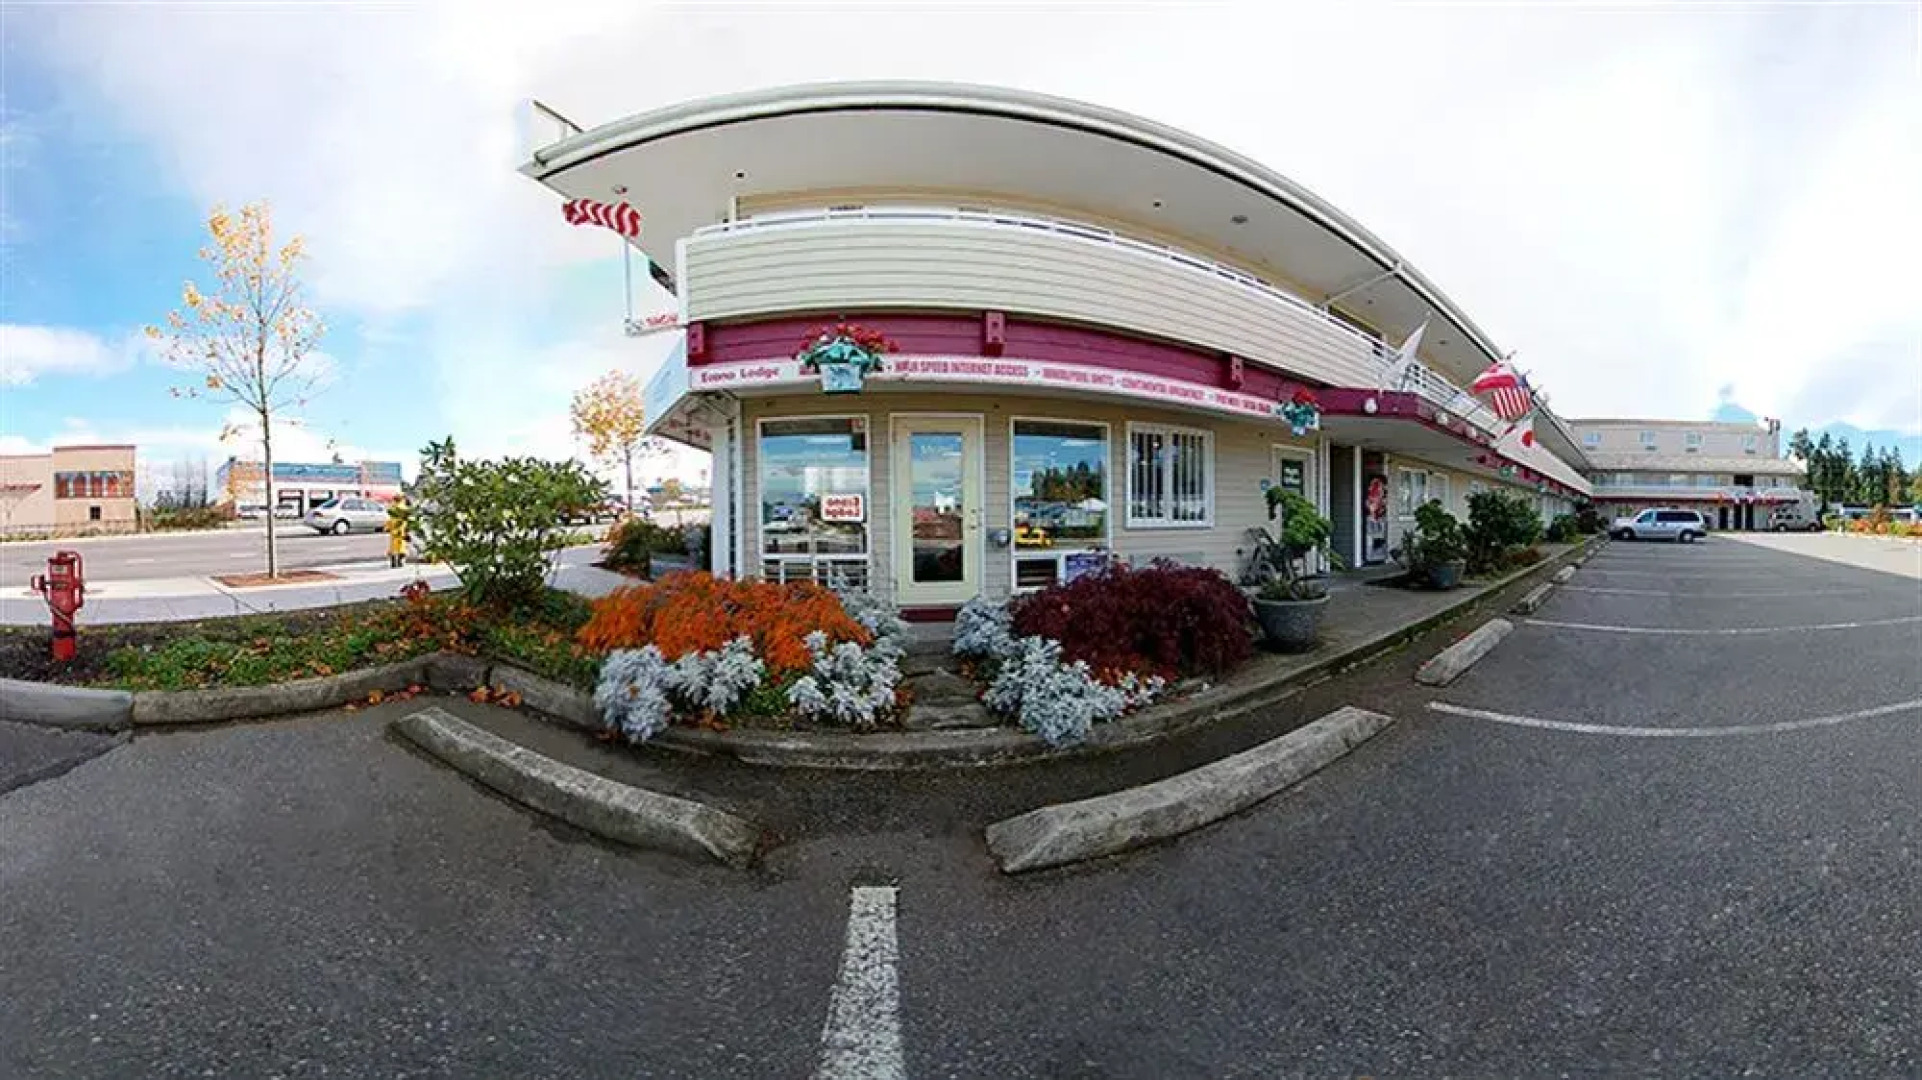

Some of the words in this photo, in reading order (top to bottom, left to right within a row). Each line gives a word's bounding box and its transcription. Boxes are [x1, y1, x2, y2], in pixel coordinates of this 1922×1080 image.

[701, 371, 736, 383] Econo
[740, 367, 779, 380] Lodge
[920, 361, 948, 373] SPEED
[951, 362, 993, 375] INTERNET
[995, 364, 1029, 377] ACCESS
